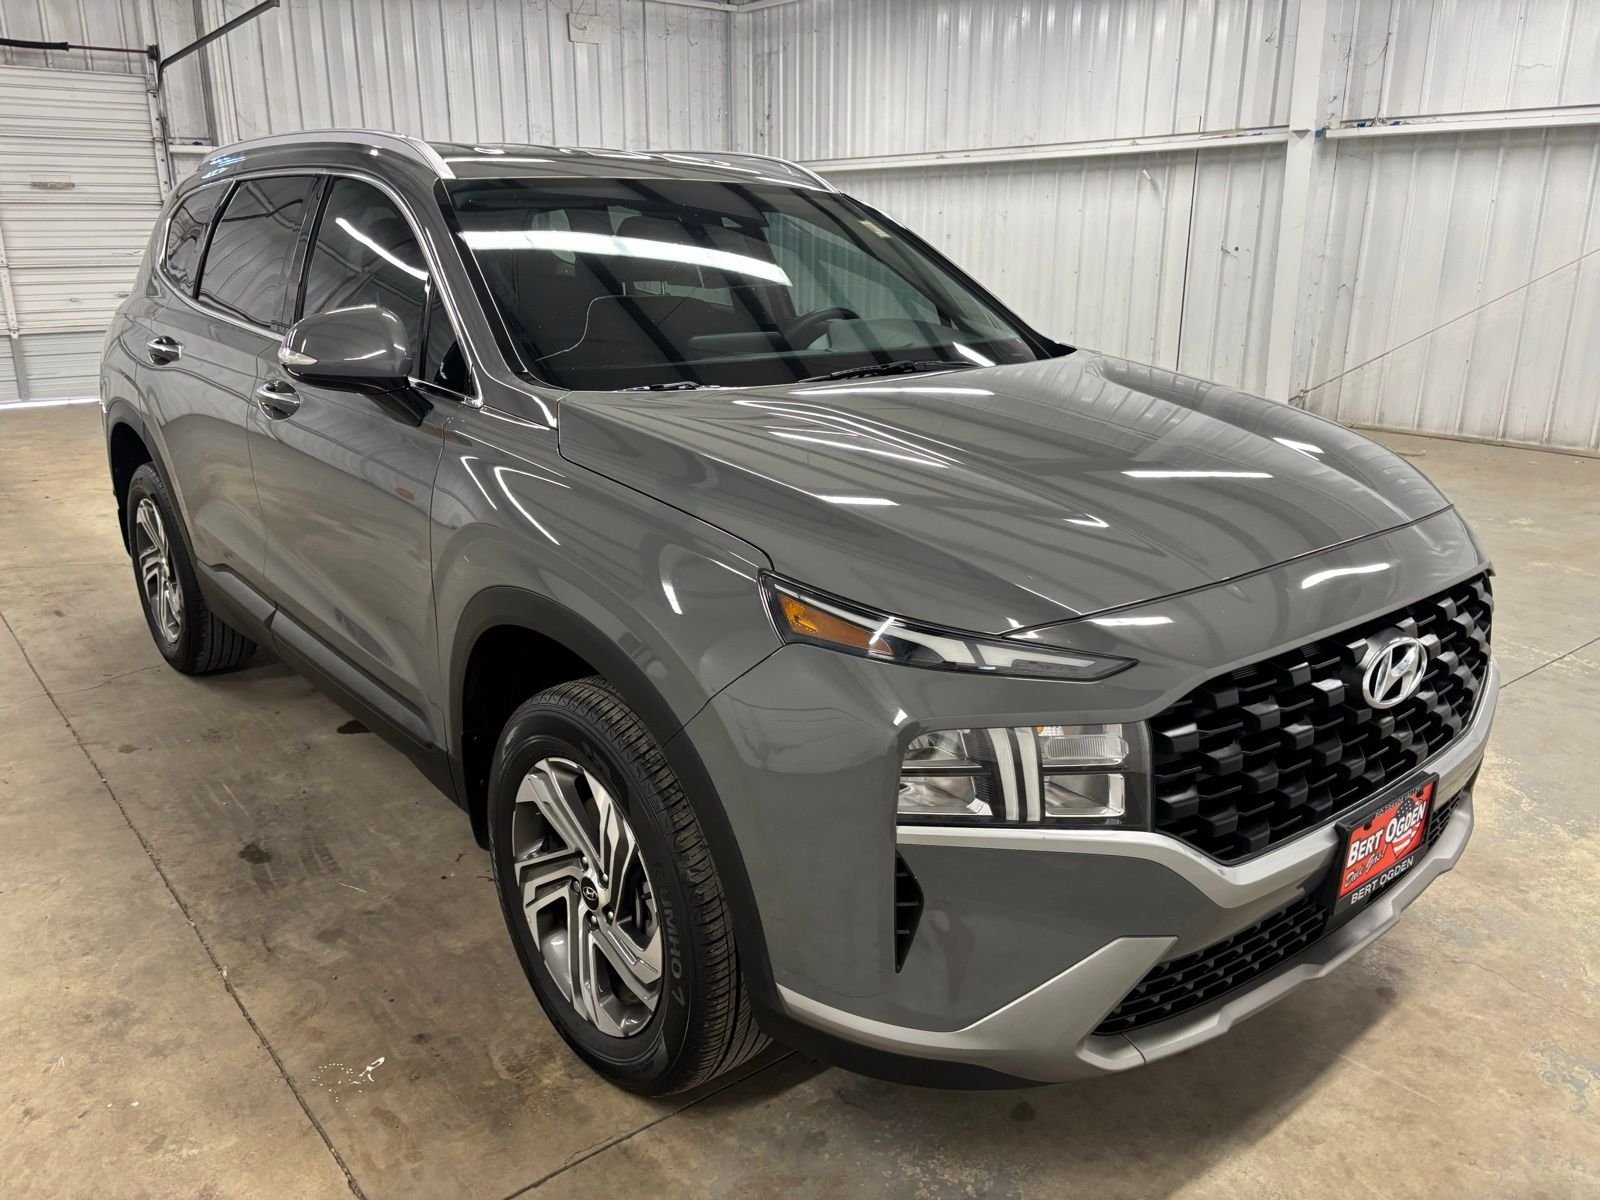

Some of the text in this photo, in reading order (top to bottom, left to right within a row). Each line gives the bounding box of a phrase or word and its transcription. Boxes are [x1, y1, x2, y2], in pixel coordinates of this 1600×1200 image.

[1346, 829, 1384, 868] BERT
[1385, 801, 1427, 842] OGDEN
[1350, 856, 1414, 904] BERT OGDEN
[653, 863, 682, 979] KUMHO
